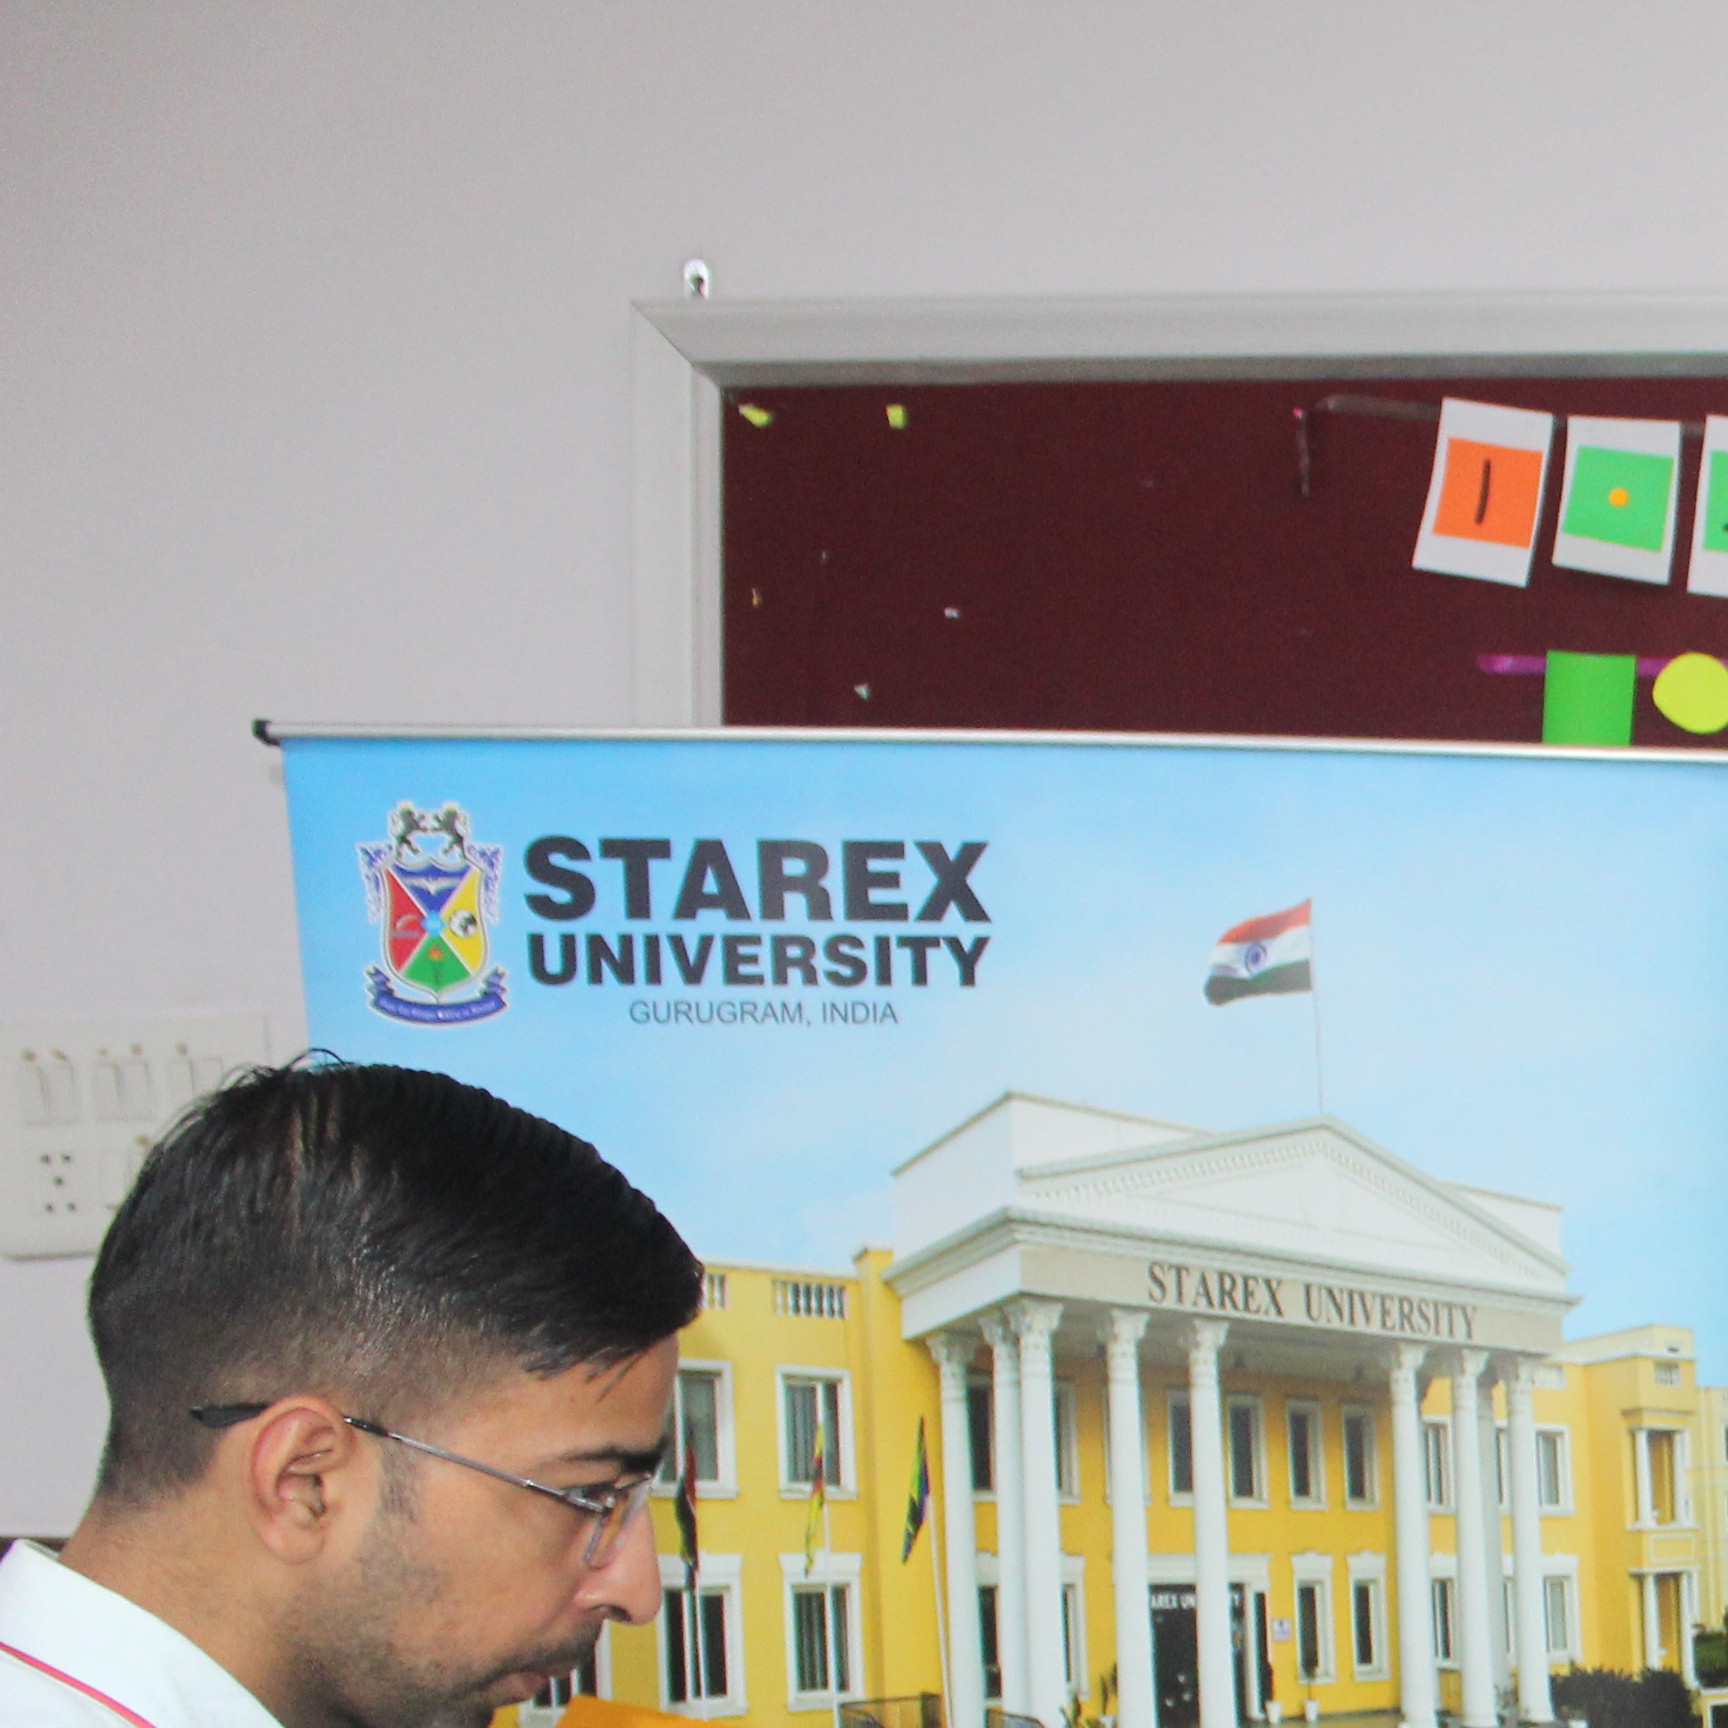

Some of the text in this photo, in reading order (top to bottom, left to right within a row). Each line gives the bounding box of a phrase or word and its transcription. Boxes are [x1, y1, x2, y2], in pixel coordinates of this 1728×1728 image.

[1469, 459, 1492, 526] 1
[523, 836, 992, 925] STAREX
[527, 932, 991, 988] UNIVERSITY
[629, 1000, 898, 1029] GURUGRAM, INDIA
[1147, 1260, 1477, 1341] STAREX UNIVERSITY
